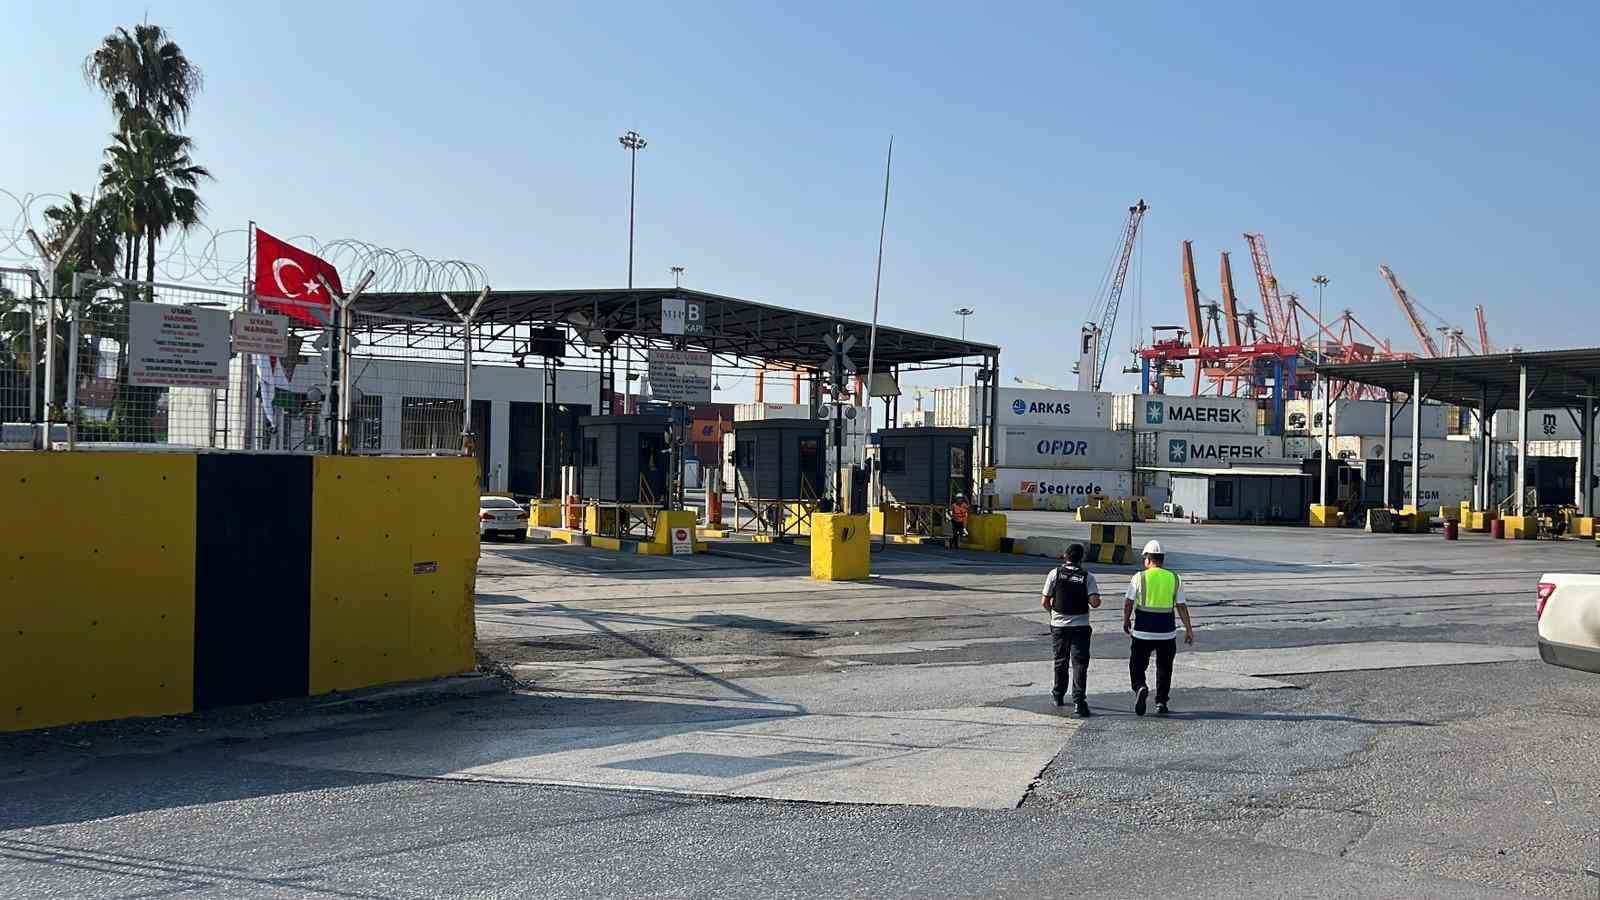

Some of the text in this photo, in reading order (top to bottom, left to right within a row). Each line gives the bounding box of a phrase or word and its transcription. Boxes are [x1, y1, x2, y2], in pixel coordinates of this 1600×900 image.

[688, 304, 700, 321] B
[1029, 401, 1071, 415] ARKAS
[1169, 406, 1242, 423] MAERSK
[1037, 440, 1088, 456] OPDR
[1190, 444, 1265, 459] MAERSK
[1039, 482, 1103, 496] Seatrade
